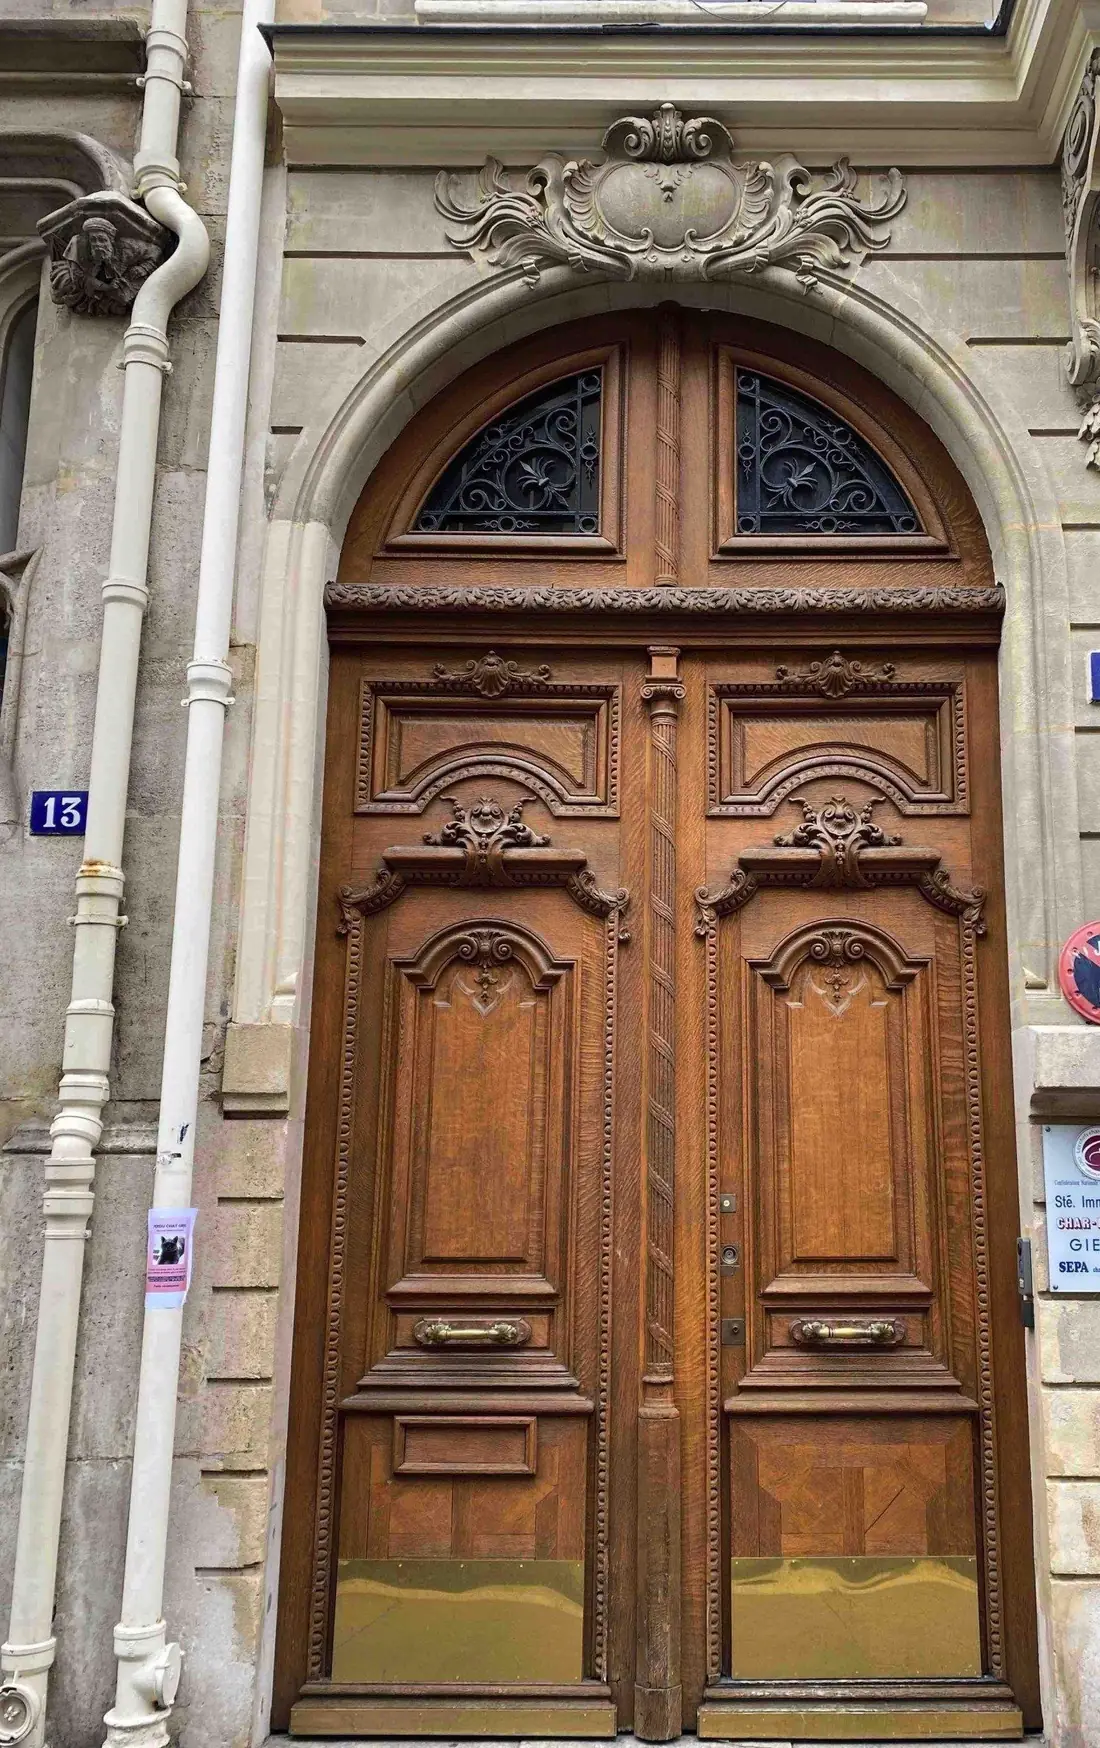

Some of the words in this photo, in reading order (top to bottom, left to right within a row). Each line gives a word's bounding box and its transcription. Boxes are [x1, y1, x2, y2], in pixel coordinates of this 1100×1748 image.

[43, 797, 81, 827] 13
[1055, 1195, 1076, 1208] Sté.
[1059, 1261, 1089, 1273] SEPA
